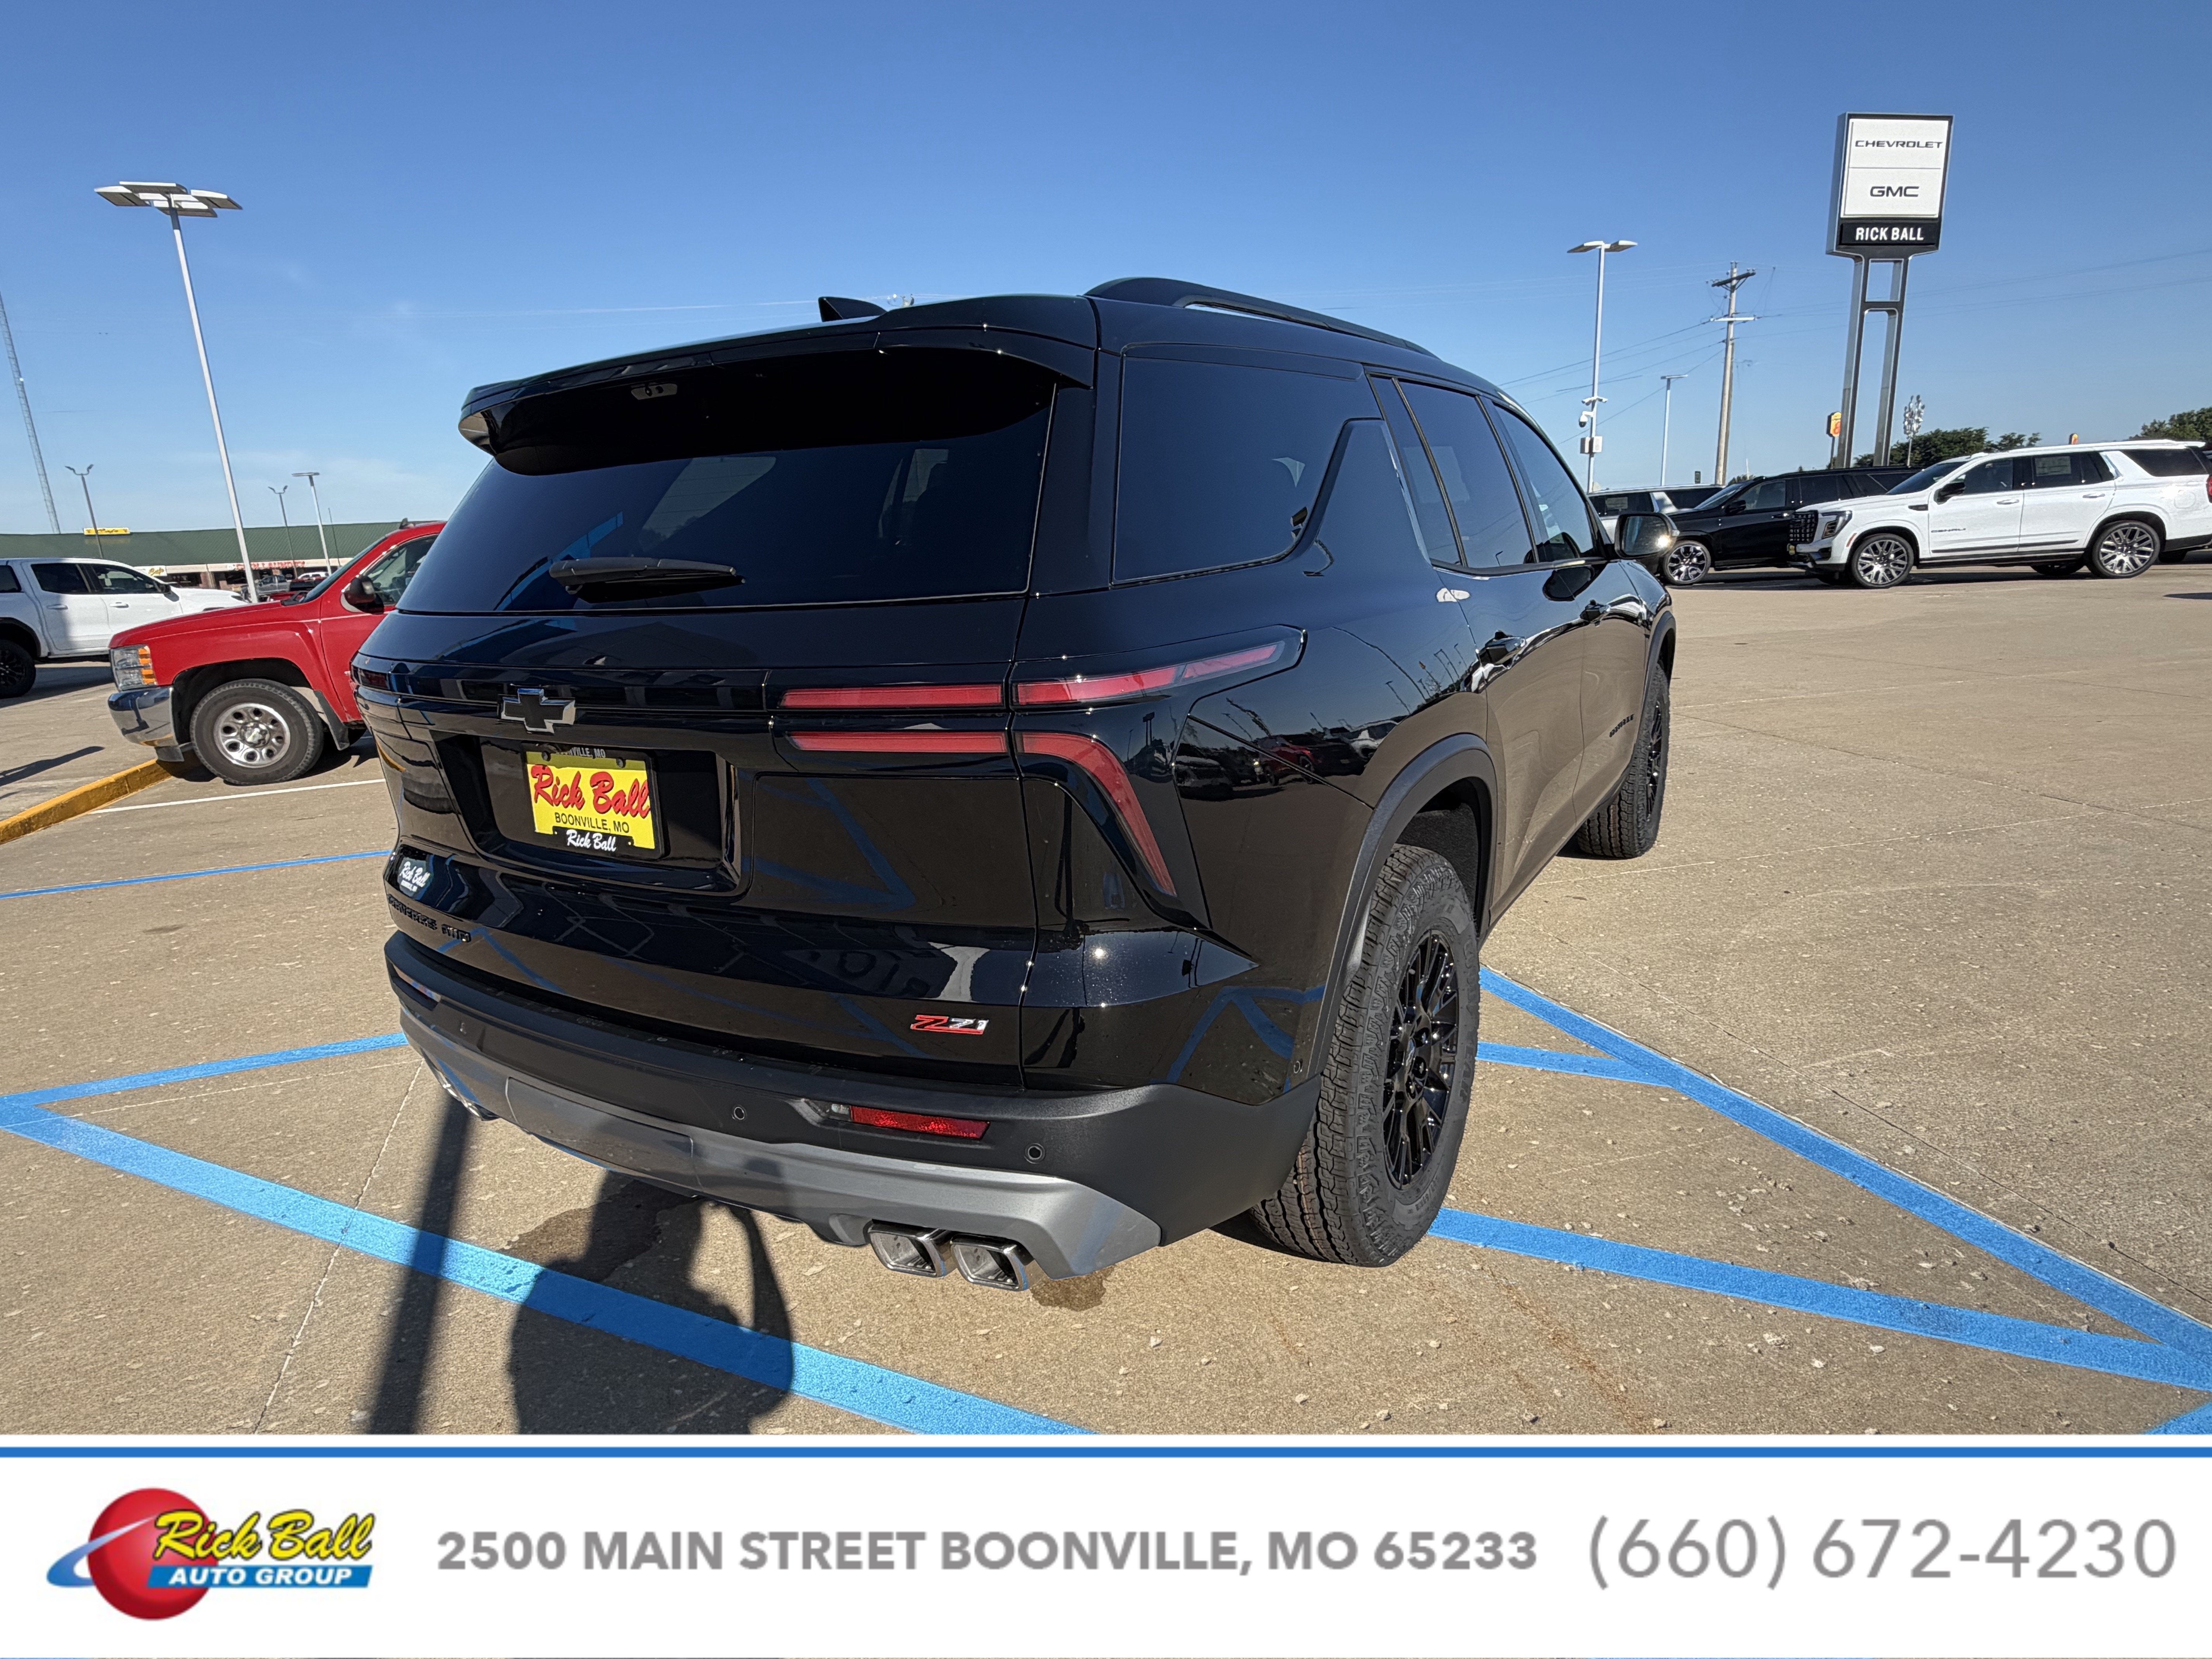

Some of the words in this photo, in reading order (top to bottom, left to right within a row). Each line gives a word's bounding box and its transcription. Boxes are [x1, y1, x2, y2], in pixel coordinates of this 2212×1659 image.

[1855, 140, 1943, 149] CHEVROLET
[1870, 186, 1920, 197] GMC
[1855, 227, 1889, 240] RICK
[1891, 227, 1924, 241] BALL
[594, 748, 606, 758] MO
[531, 764, 585, 811] Rick
[590, 771, 651, 819] Ball
[555, 812, 611, 832] BOONVILLE,
[613, 821, 629, 833] MO
[566, 830, 592, 848] Rick
[592, 833, 617, 852] Ball
[910, 1014, 989, 1035] Z71
